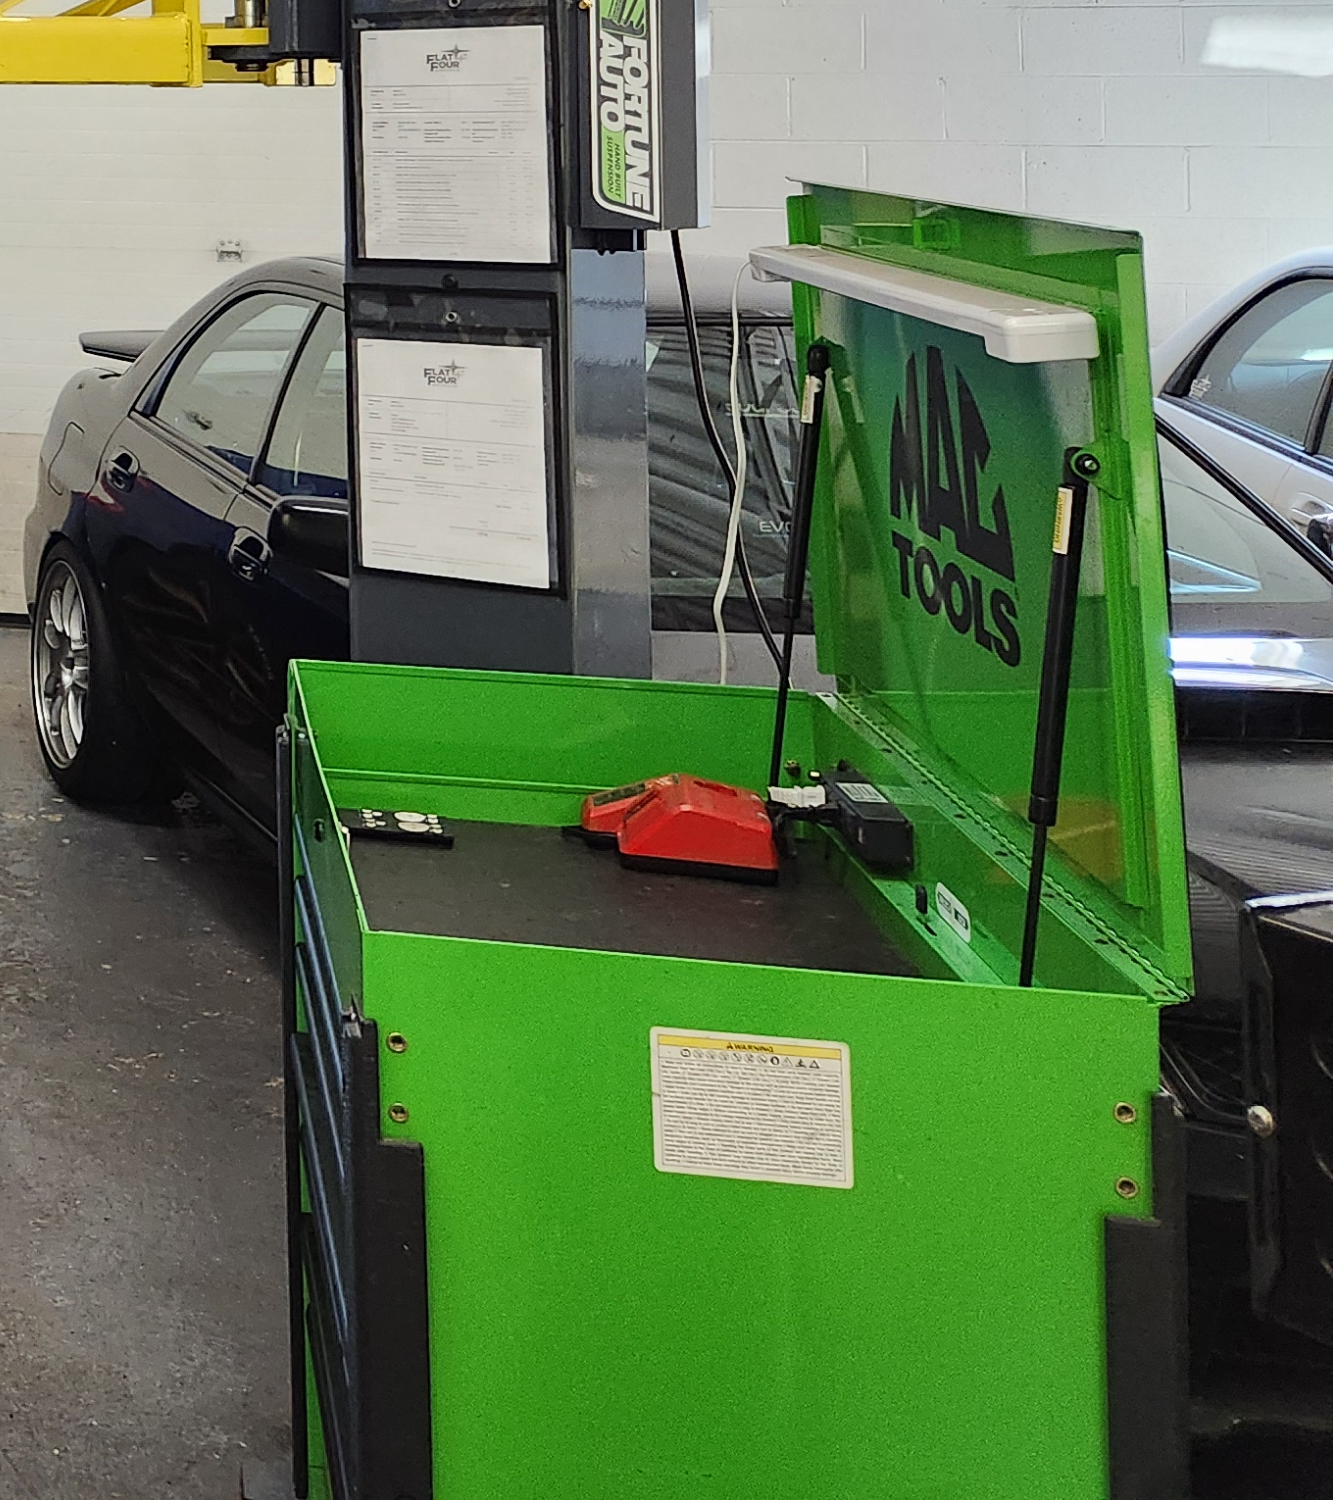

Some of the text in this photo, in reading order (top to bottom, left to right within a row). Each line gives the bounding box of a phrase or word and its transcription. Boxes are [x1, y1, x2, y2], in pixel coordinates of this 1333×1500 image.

[426, 54, 453, 64] FLAT
[430, 61, 460, 72] FOUR
[599, 30, 625, 132] AUTO
[623, 38, 650, 211] FORTUNE
[606, 135, 614, 194] SUSPENSION
[424, 368, 450, 378] FLAT
[428, 376, 457, 386] FOUR
[890, 346, 1016, 583] MAC
[891, 529, 1022, 668] TOOLS
